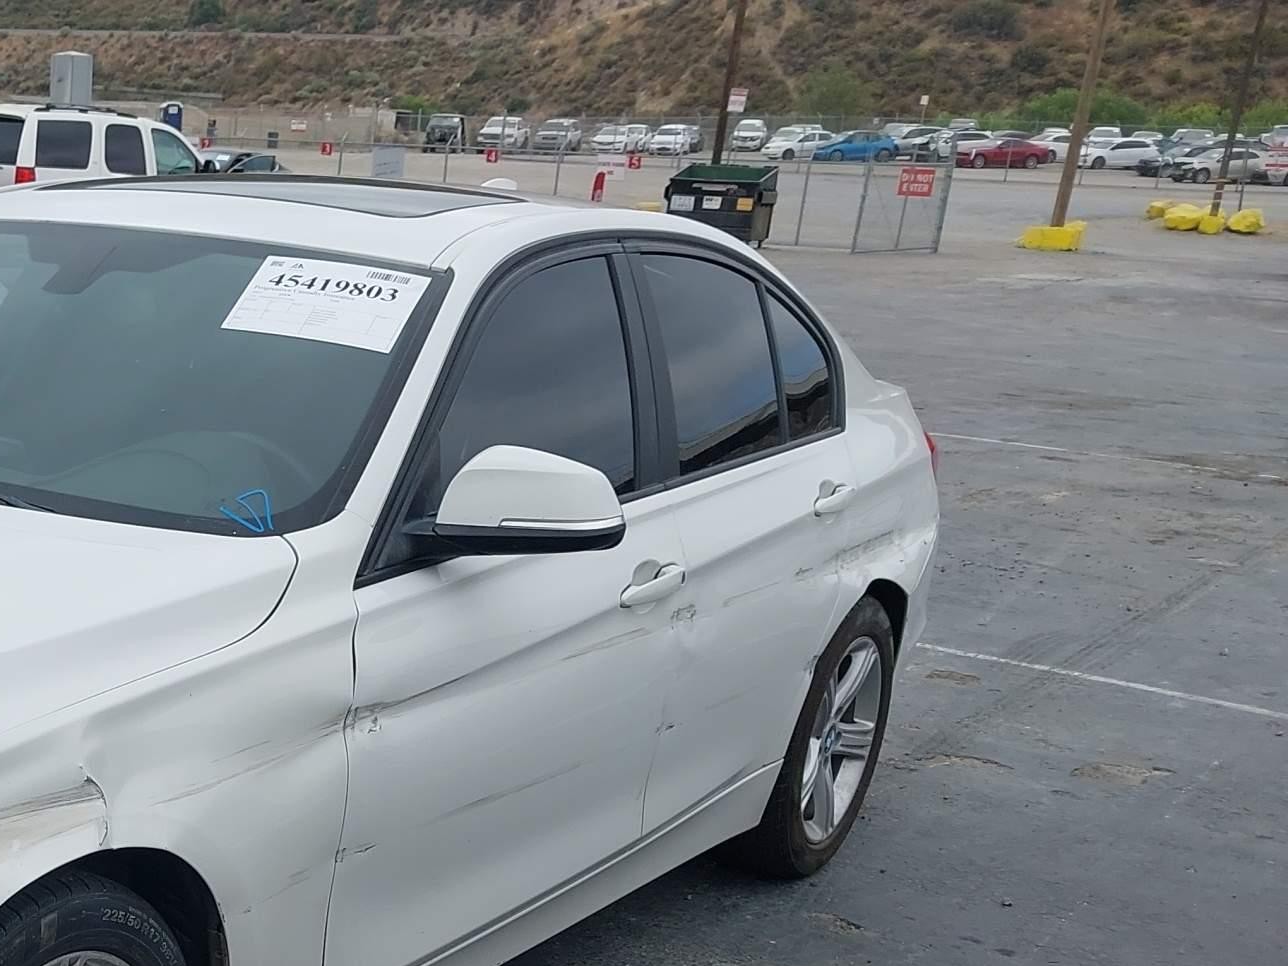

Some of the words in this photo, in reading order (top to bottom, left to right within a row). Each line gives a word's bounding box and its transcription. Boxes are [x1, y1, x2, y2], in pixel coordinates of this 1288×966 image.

[323, 143, 331, 154] 3
[487, 151, 496, 161] 4
[631, 157, 640, 169] 5
[268, 273, 399, 302] 45419803
[102, 909, 142, 930] 225/50
